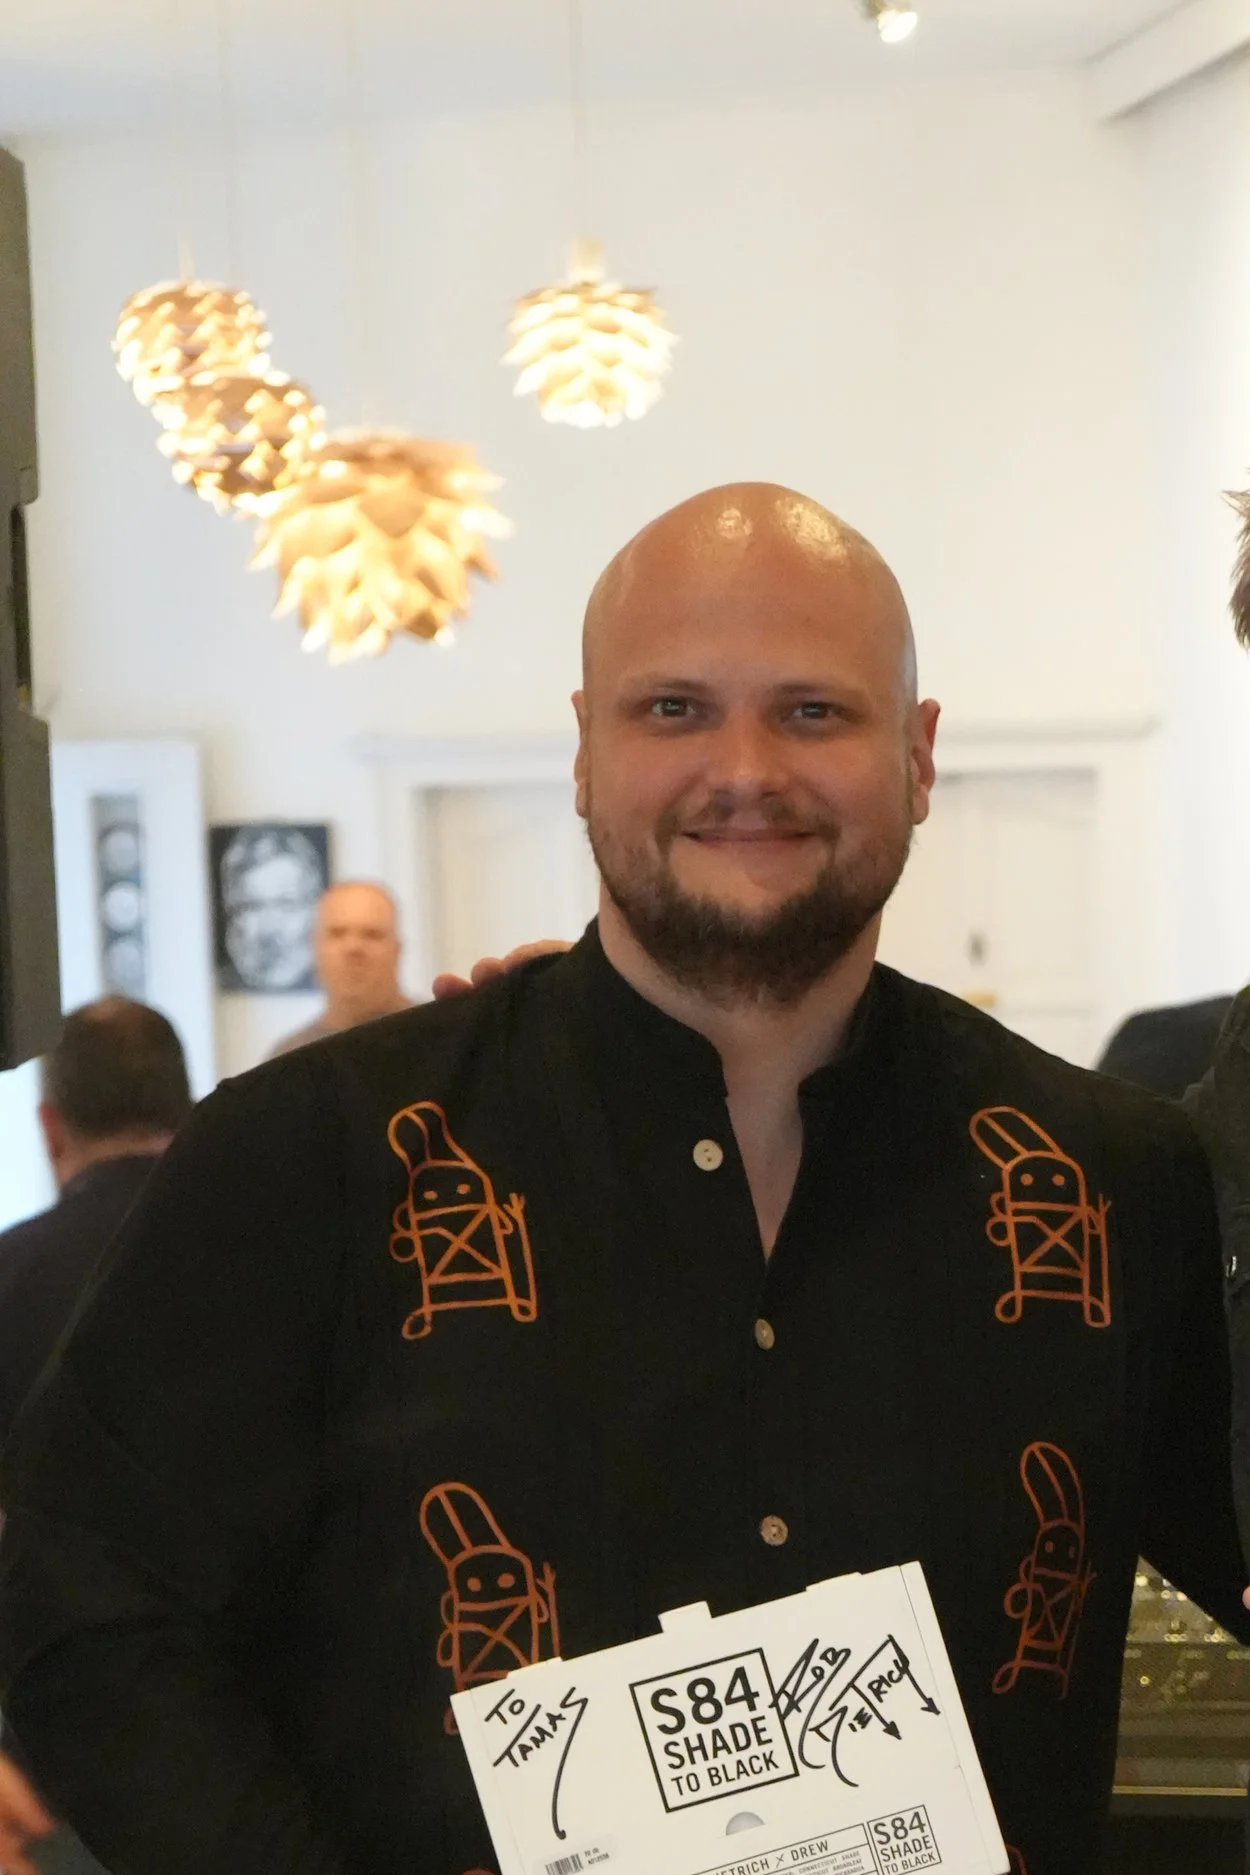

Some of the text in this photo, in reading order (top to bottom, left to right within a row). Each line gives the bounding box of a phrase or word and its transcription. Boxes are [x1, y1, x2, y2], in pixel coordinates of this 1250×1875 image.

[484, 1688, 525, 1725] TO
[650, 1665, 760, 1735] S84
[663, 1715, 773, 1769] SHADE
[492, 1686, 588, 1840] TAMAS
[671, 1750, 779, 1796] TO BLACK
[874, 1811, 926, 1845] S84
[790, 1840, 829, 1862] DREW
[880, 1835, 932, 1862] SHADE
[885, 1851, 936, 1875] TO BLACK
